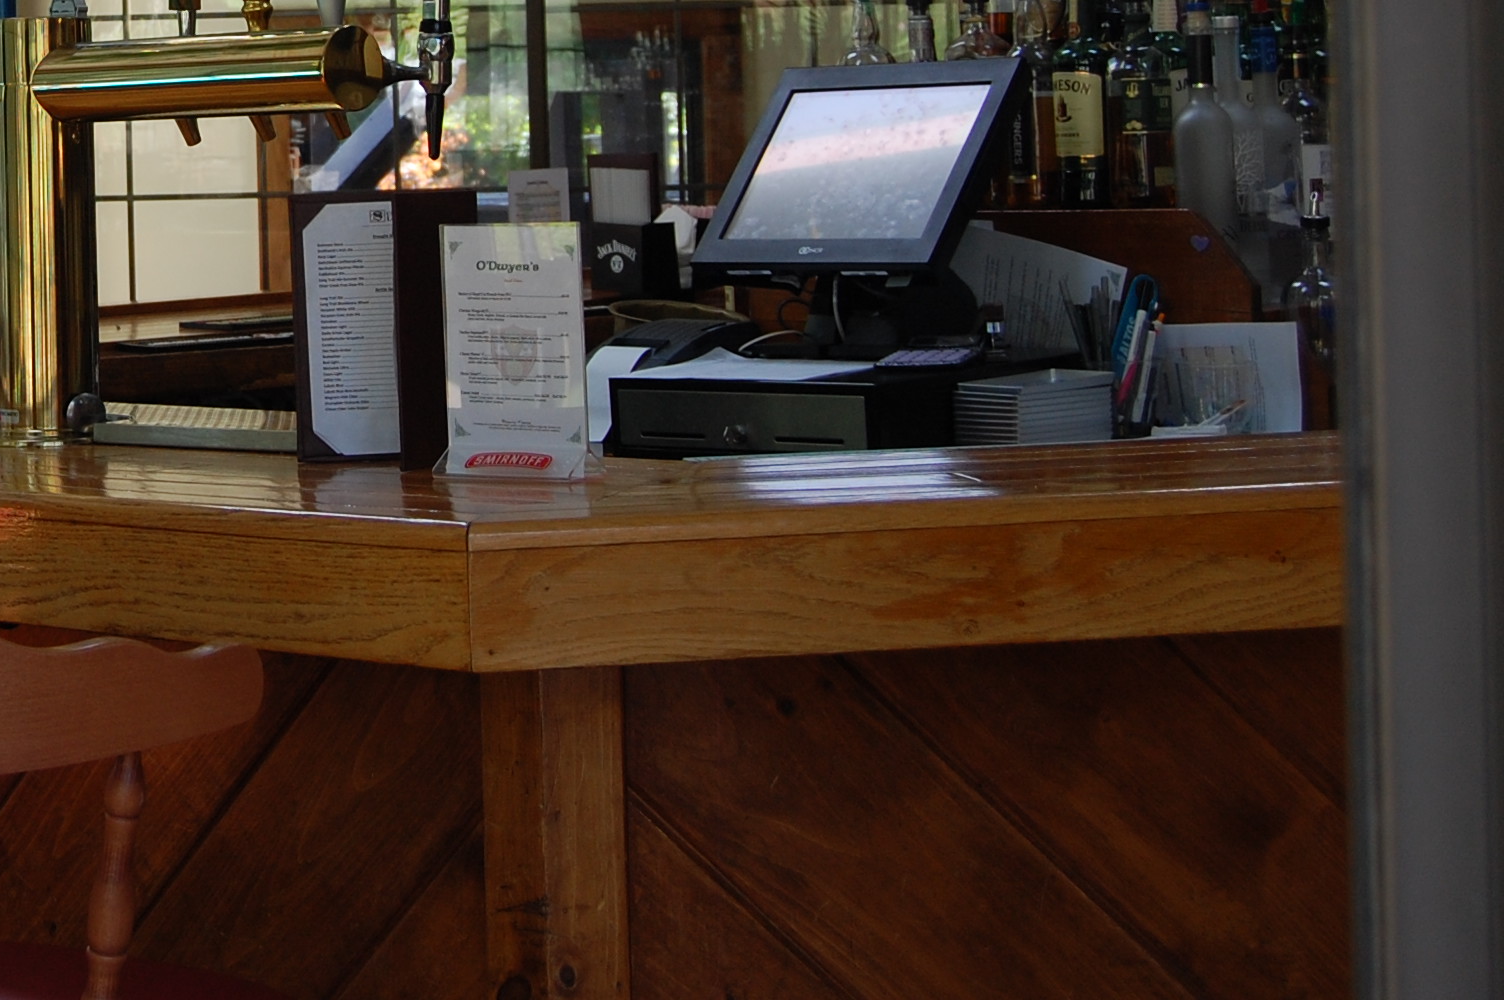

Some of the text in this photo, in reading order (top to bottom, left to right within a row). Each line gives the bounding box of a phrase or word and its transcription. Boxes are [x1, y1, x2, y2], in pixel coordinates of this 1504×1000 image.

[596, 242, 613, 260] JACK
[475, 260, 540, 274] O'Dwyer's
[473, 453, 545, 466] SMIRNOFF
